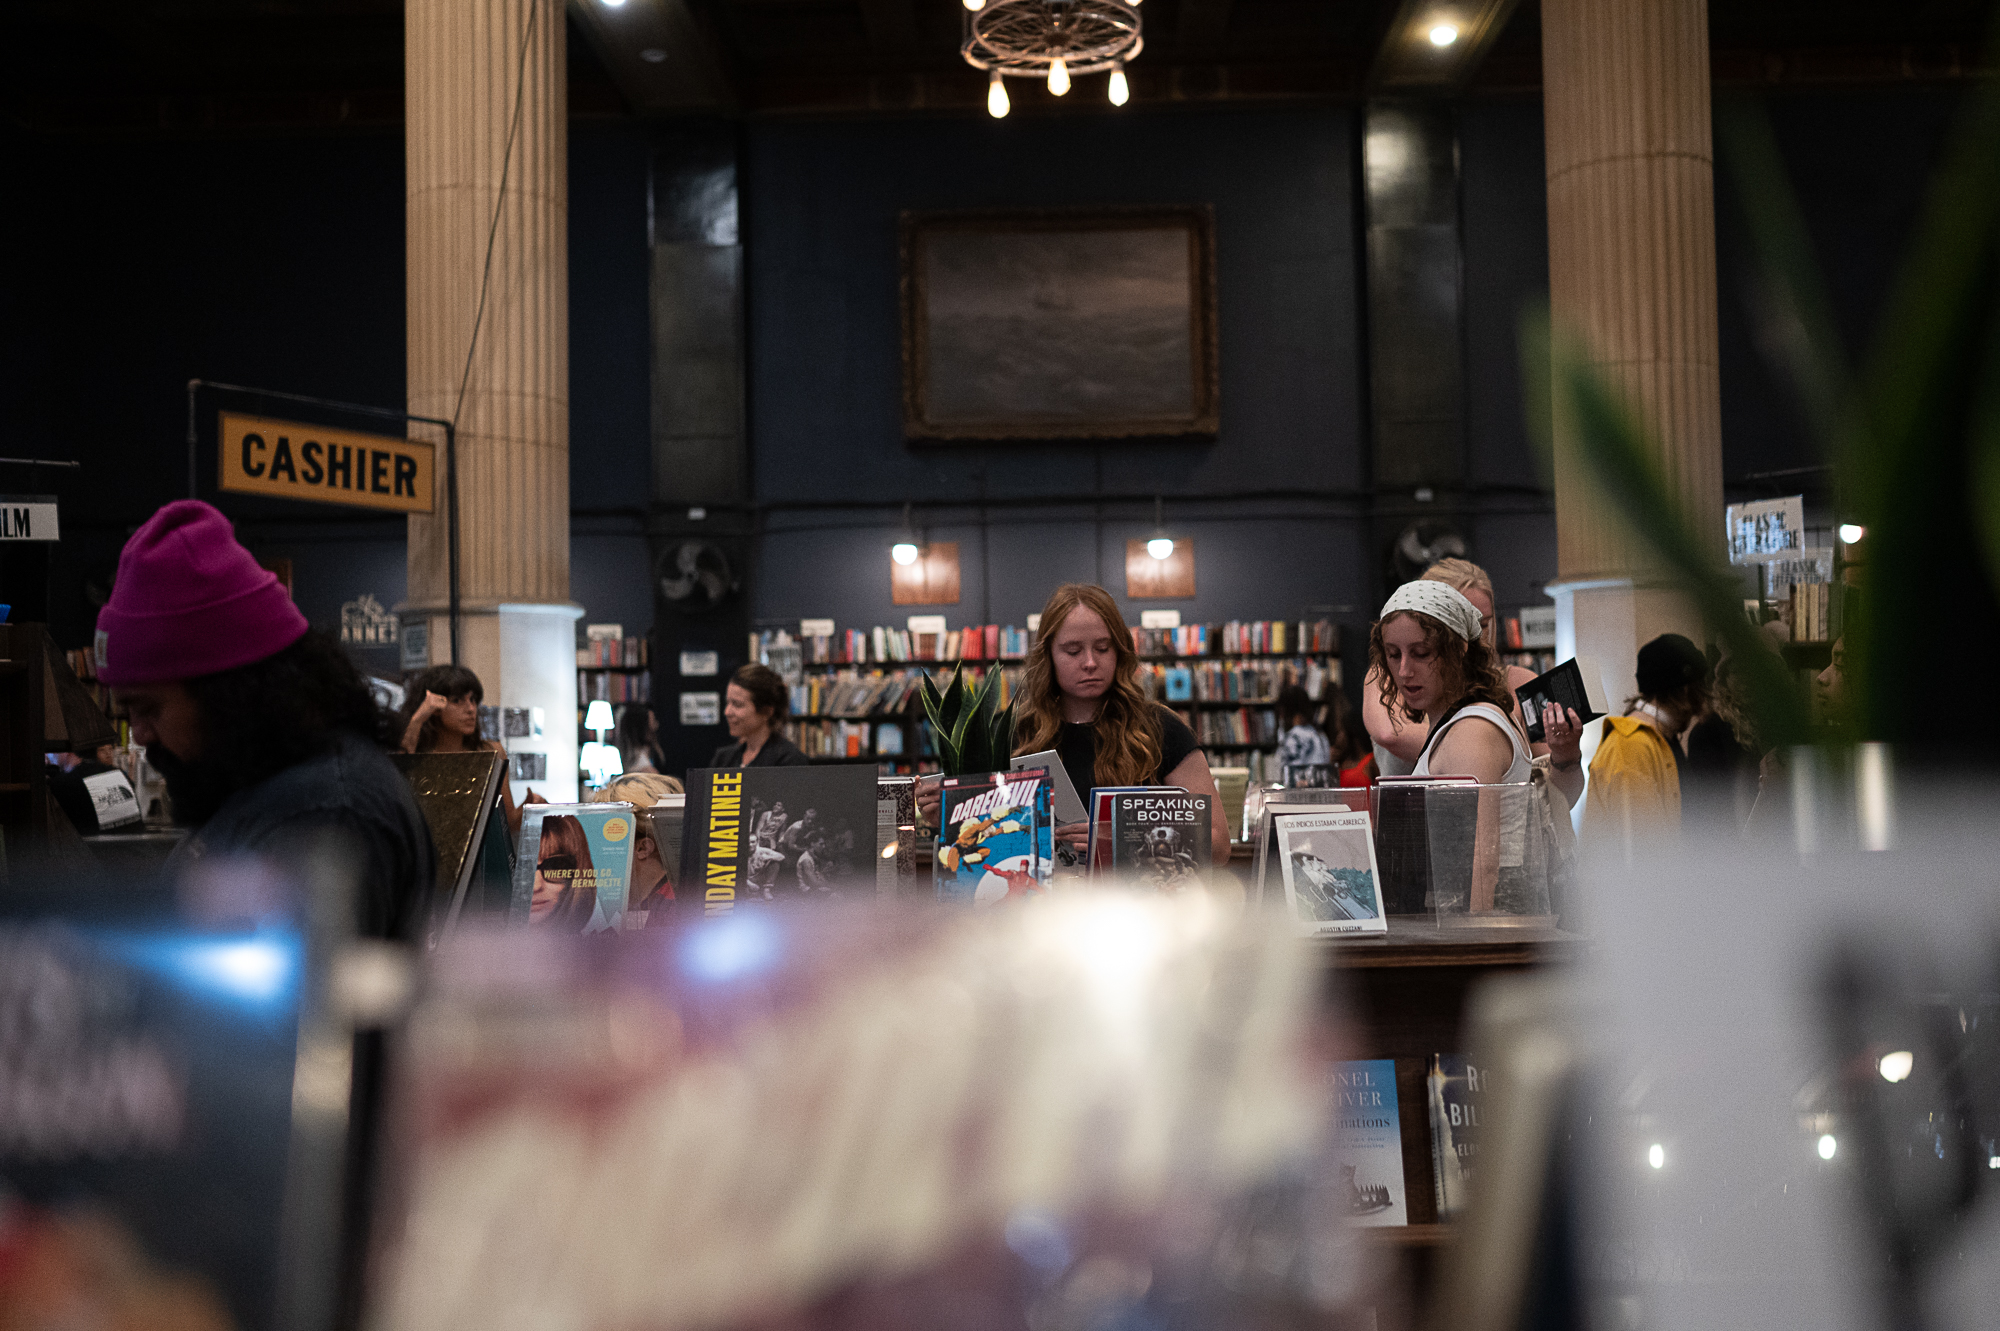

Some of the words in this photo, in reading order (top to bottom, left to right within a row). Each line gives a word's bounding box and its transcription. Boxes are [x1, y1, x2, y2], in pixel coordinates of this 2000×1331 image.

[241, 433, 417, 498] CASHIER
[1122, 799, 1206, 810] SPEAKING
[708, 772, 742, 858] MATINEE
[1137, 811, 1195, 821] BONES
[1296, 820, 1314, 828] INDIOS
[1315, 819, 1337, 827] ESTABAN
[1338, 818, 1367, 826] CABREROS
[543, 869, 580, 879] WHERE'D
[582, 868, 599, 878] YOU
[571, 878, 622, 889] BERNADETTE
[704, 862, 737, 916] NDAY
